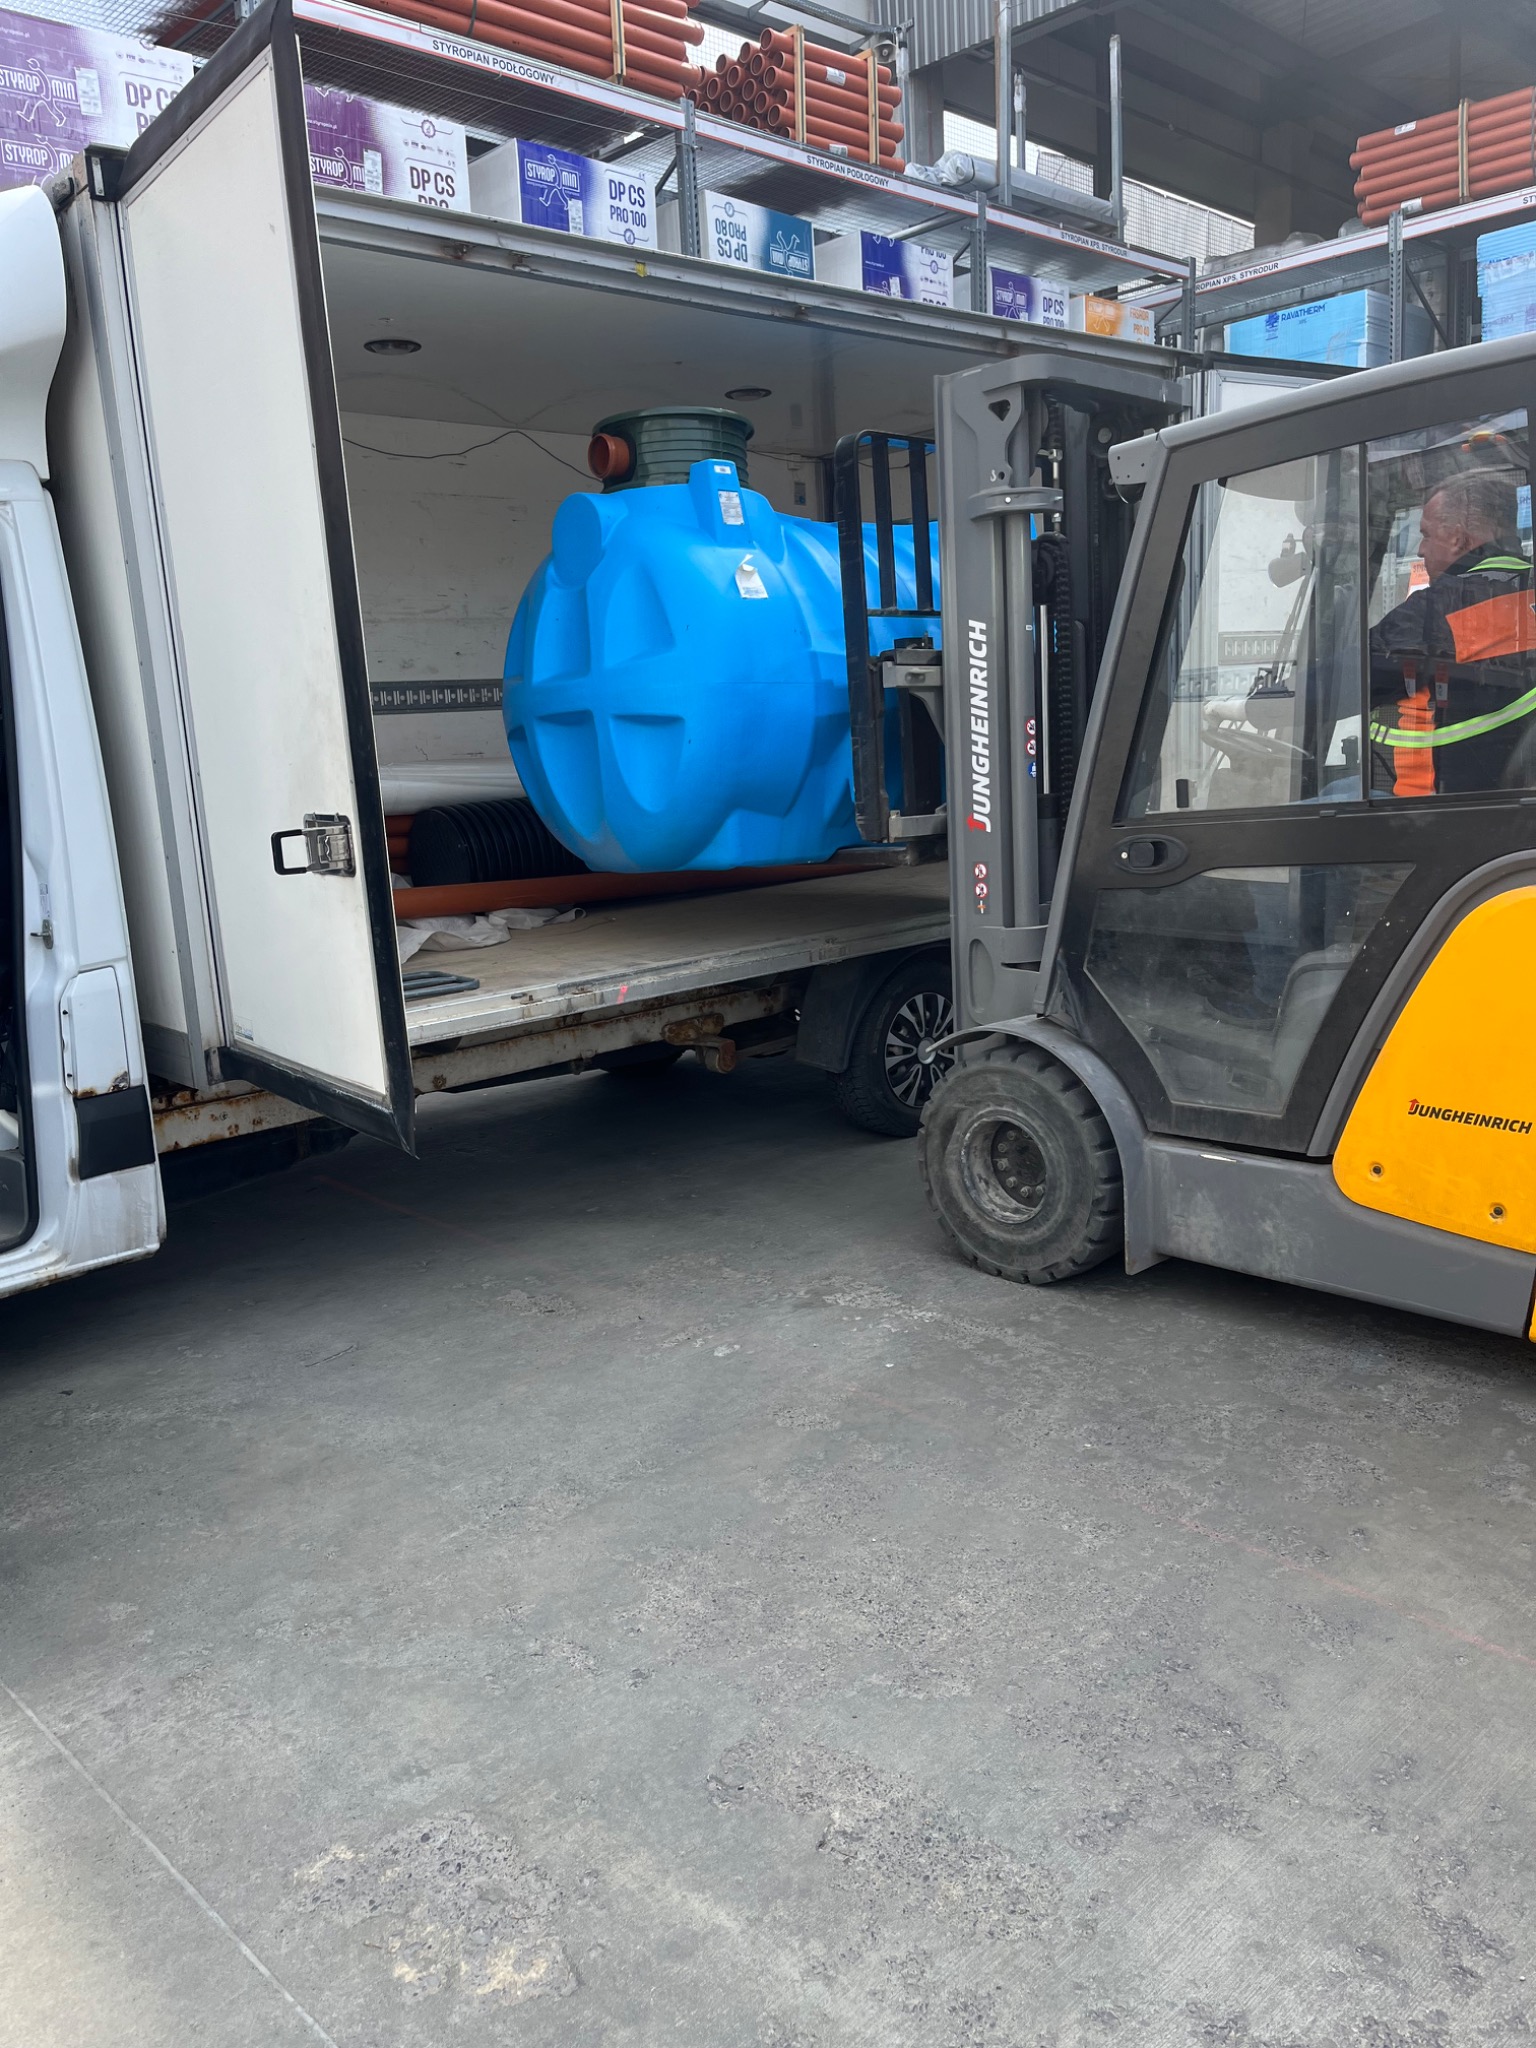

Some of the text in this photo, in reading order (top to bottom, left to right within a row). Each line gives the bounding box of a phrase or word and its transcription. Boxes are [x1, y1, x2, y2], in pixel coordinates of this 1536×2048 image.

[432, 39, 554, 84] STYROPIAN PODŁOGOWY
[0, 69, 41, 92] STYROP
[124, 81, 152, 109] DP
[5, 143, 48, 166] STYROP
[310, 156, 344, 177] STYROP
[353, 166, 365, 182] MI
[410, 166, 431, 191] DP
[434, 172, 455, 198] CS
[527, 163, 556, 183] STYROP
[806, 155, 889, 187] STYROPIAN PODŁOGOWY
[609, 179, 646, 208] DP CS
[610, 205, 647, 228] PRO 100
[715, 218, 747, 241] PRO 80
[717, 237, 748, 263] DP CS
[1061, 231, 1089, 246] STYROPIAN
[1196, 279, 1221, 291] ROPIAN
[1239, 262, 1279, 279] STYRODUR
[1042, 296, 1064, 316] DP CS
[1281, 303, 1326, 321] RAVATHERM
[1133, 323, 1143, 335] PRO
[968, 620, 992, 833] JUNGHEINRICH
[1408, 1101, 1533, 1135] JUNGHEINRICH
